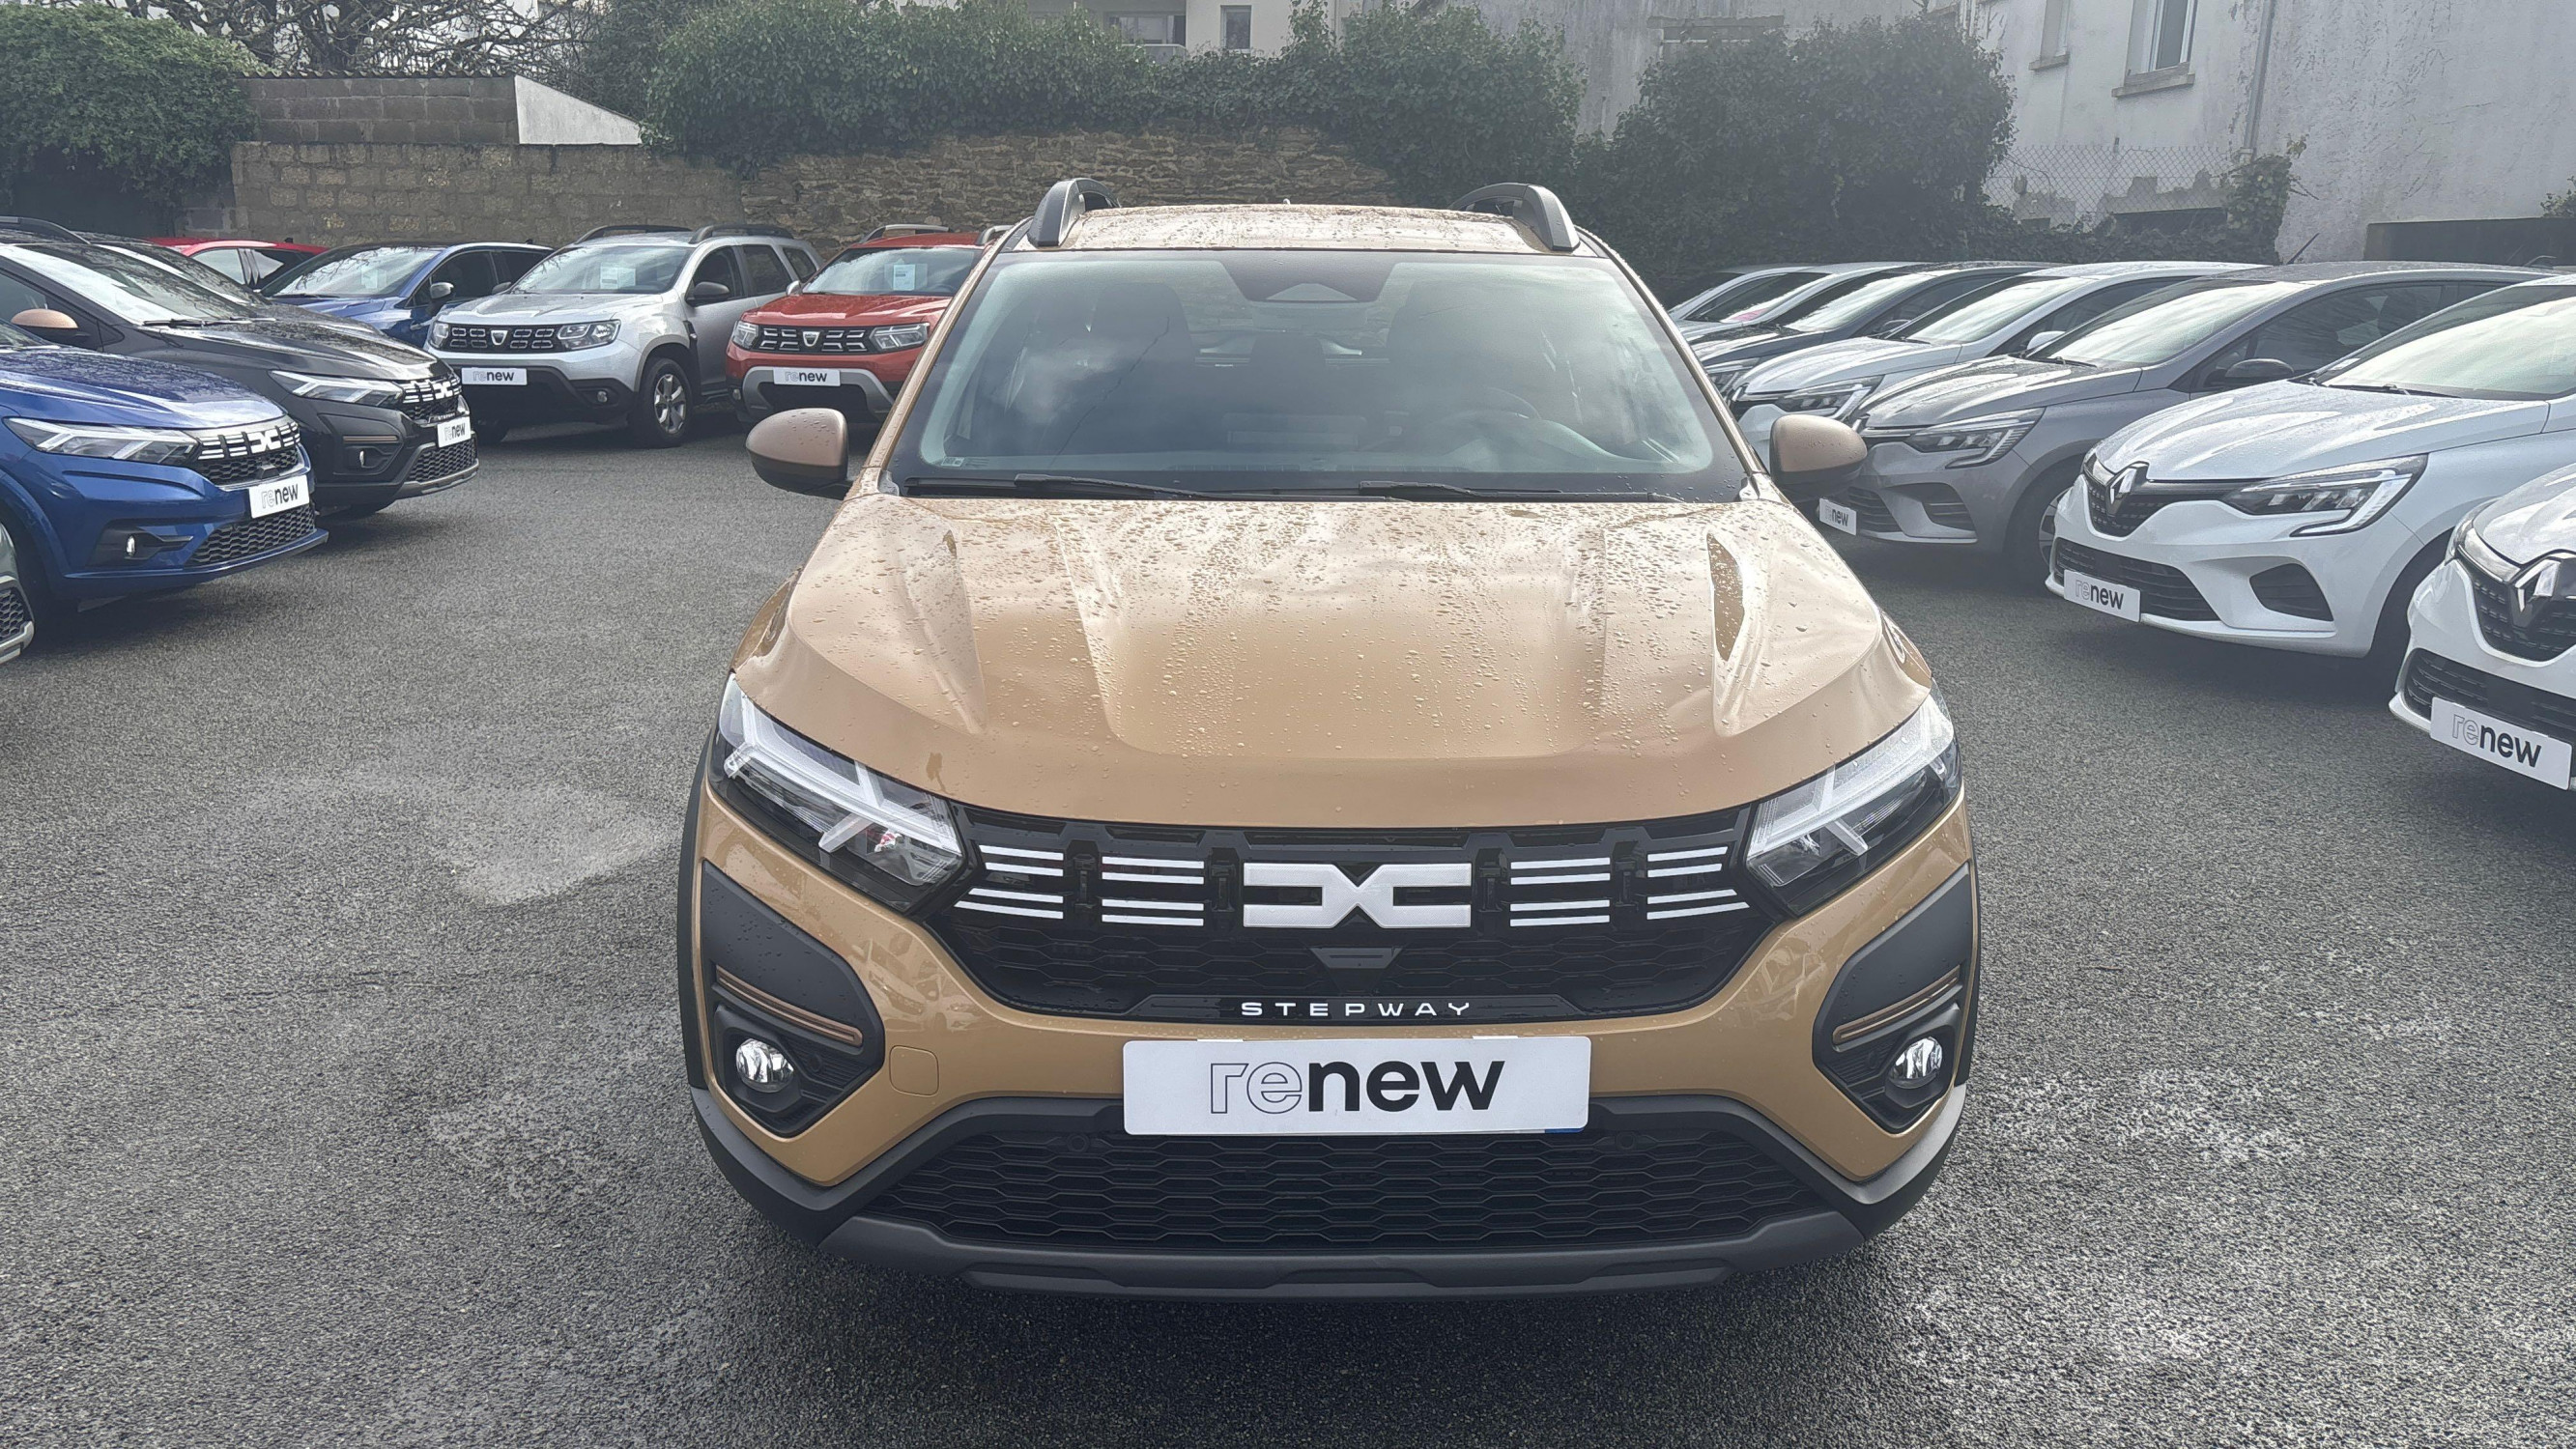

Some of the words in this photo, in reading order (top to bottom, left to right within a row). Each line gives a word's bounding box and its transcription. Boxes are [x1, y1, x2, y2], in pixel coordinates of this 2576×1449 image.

[472, 371, 514, 382] renew
[785, 371, 827, 383] renew
[261, 483, 299, 509] renew
[2075, 580, 2124, 610] renew
[2451, 713, 2542, 768] renew
[1241, 1001, 1471, 1017] STEPWAY
[1210, 1060, 1505, 1115] renew
